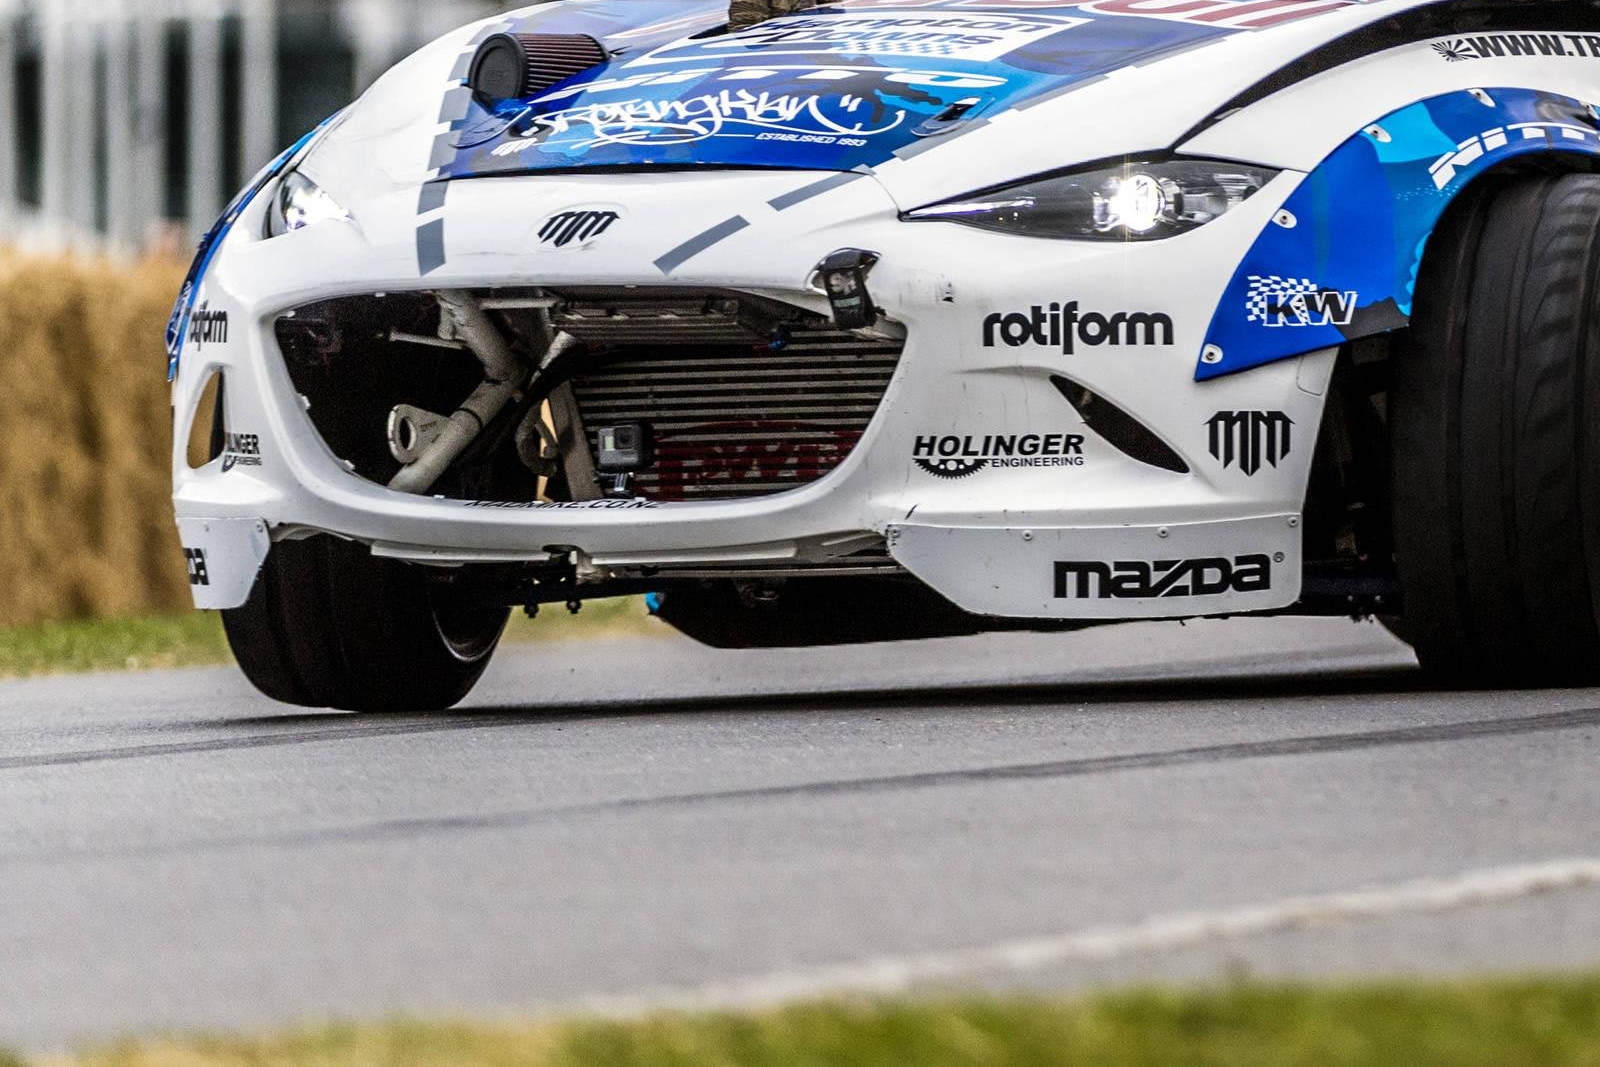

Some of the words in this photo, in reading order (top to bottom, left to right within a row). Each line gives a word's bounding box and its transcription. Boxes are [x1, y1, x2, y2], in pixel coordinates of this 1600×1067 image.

[756, 133, 836, 146] ESTABLISHED
[837, 136, 868, 147] 1993
[1262, 290, 1358, 327] KW
[983, 300, 1175, 355] rotiform
[913, 434, 1086, 457] HOLINGER
[991, 456, 1085, 469] ENGINEERING
[1053, 553, 1272, 599] mazda
